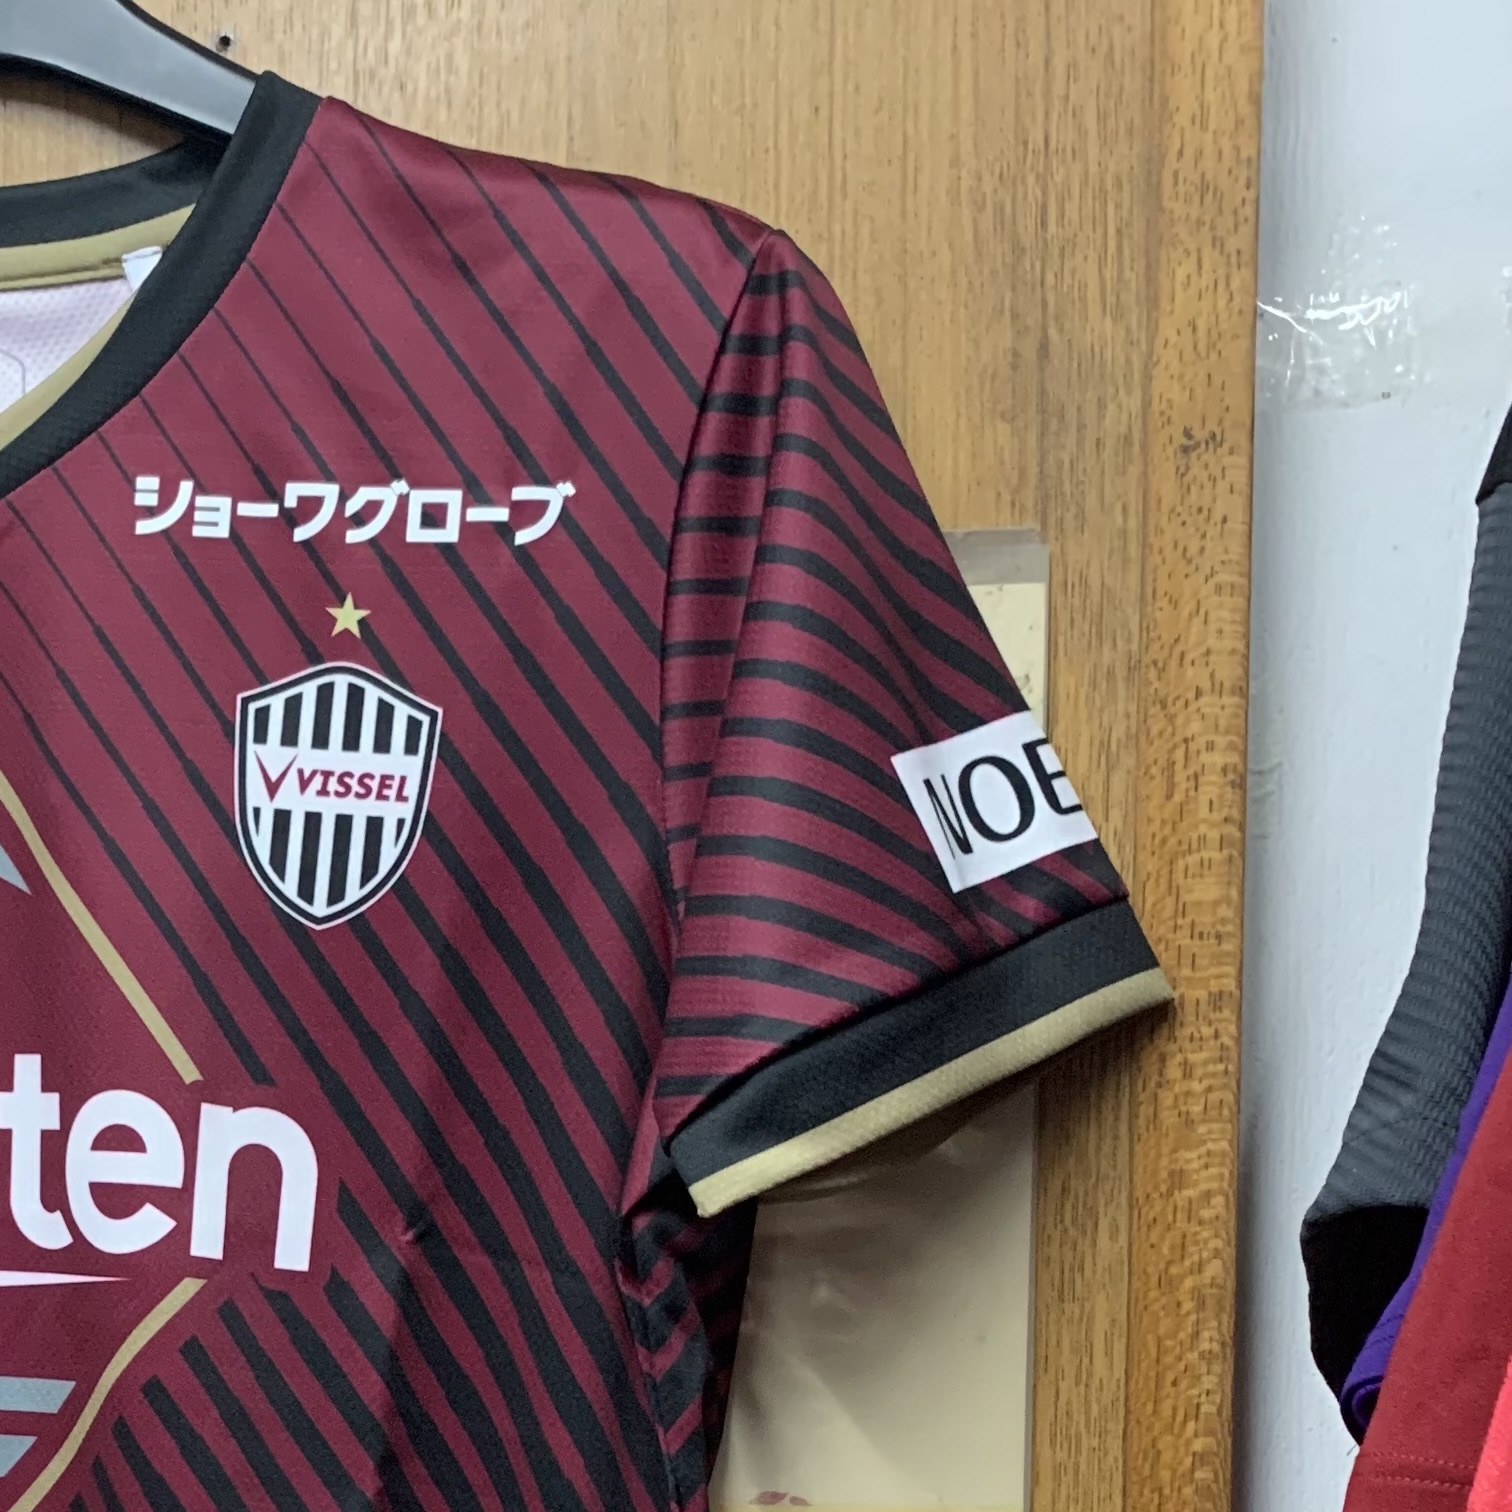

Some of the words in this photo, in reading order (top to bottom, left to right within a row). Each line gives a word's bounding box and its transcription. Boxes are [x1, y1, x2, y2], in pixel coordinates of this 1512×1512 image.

[133, 475, 577, 546] ショーワグローブ
[296, 767, 410, 804] VISSEL
